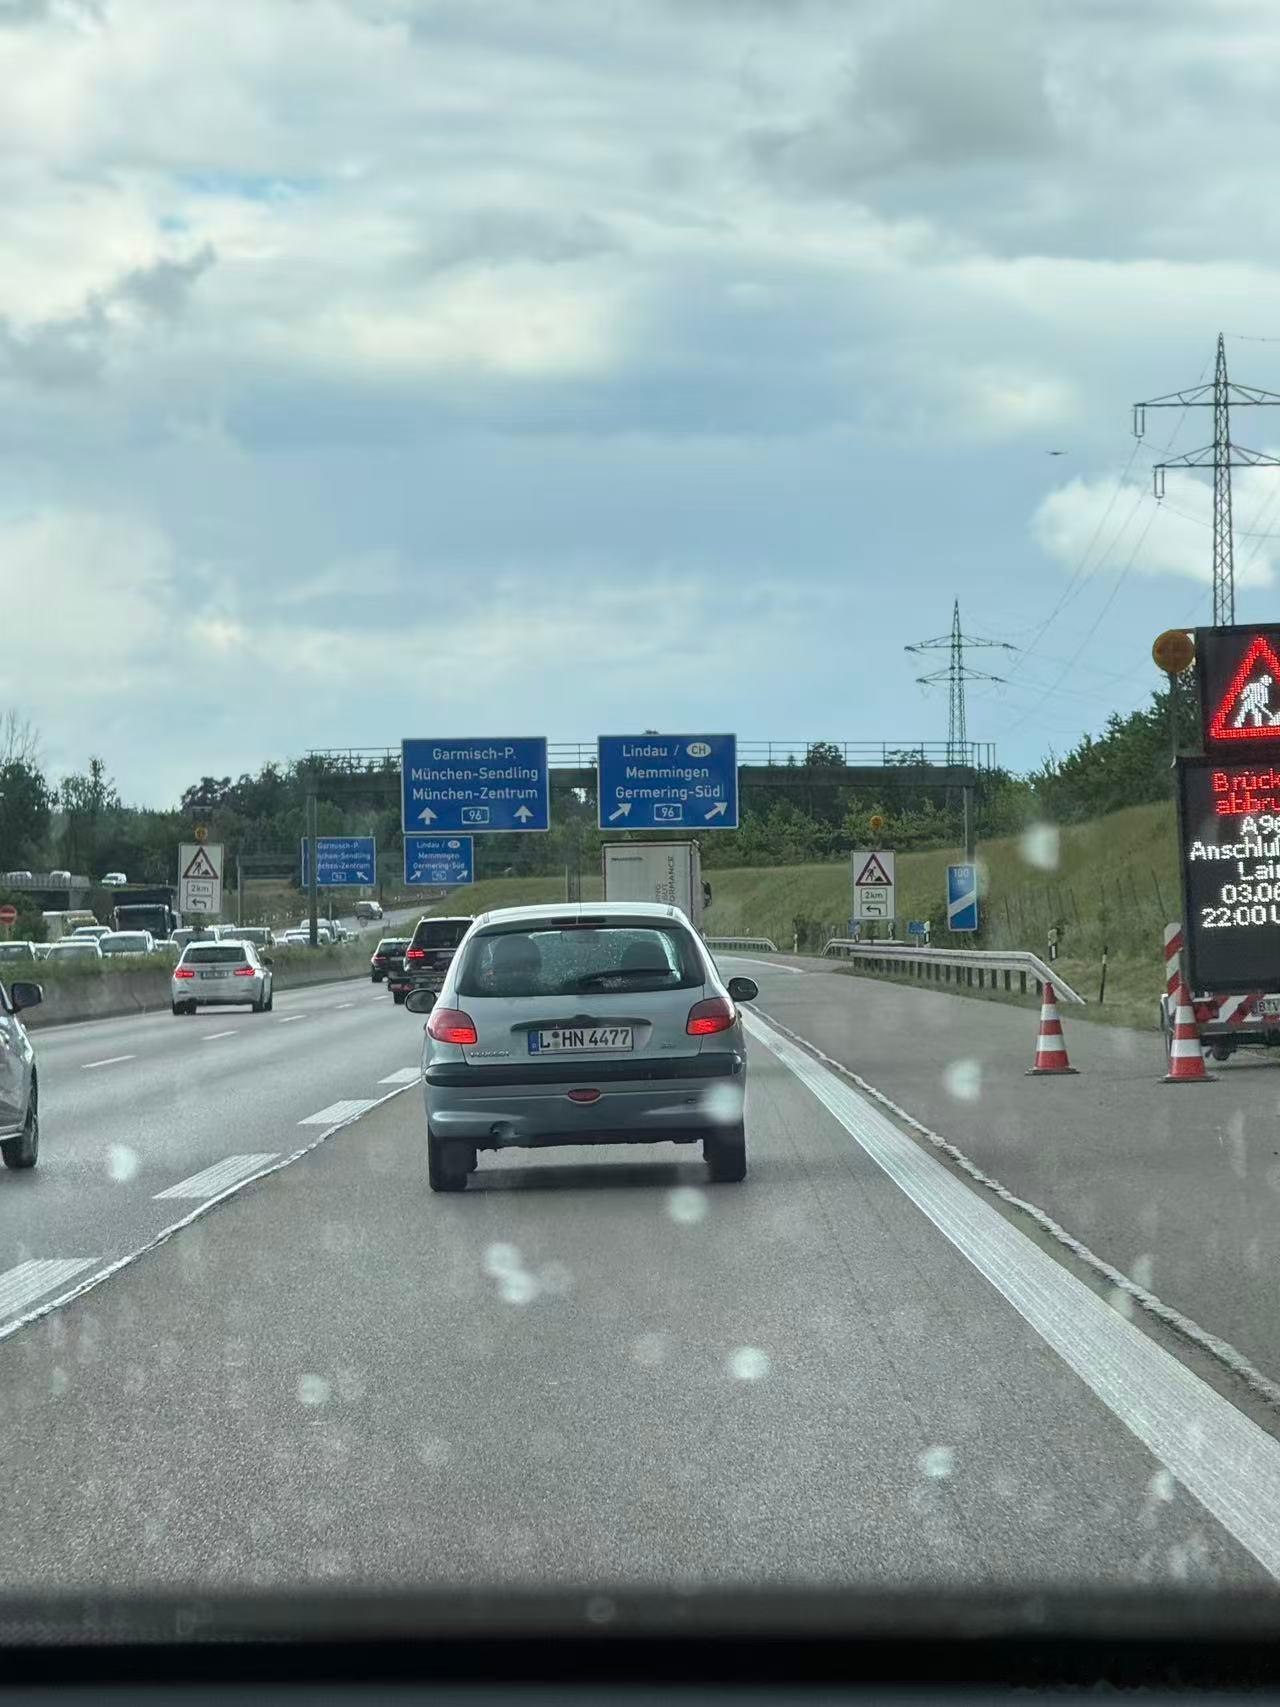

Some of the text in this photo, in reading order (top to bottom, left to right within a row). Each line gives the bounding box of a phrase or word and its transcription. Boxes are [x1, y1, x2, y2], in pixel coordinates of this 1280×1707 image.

[432, 747, 517, 760] Garmisch-P.
[623, 744, 668, 756] Lindau
[691, 745, 706, 755] CH
[411, 767, 538, 781] München-Sendling
[626, 766, 709, 780] Memmingen
[412, 787, 538, 800] München-Zentrum
[615, 785, 720, 800] Germering-Süd
[469, 811, 482, 820] 96
[661, 807, 674, 817] 96
[953, 868, 969, 878] 100
[1202, 905, 1266, 928] 22:00
[540, 1032, 551, 1048] L
[562, 1030, 584, 1047] HN
[588, 1029, 630, 1046] 4477
